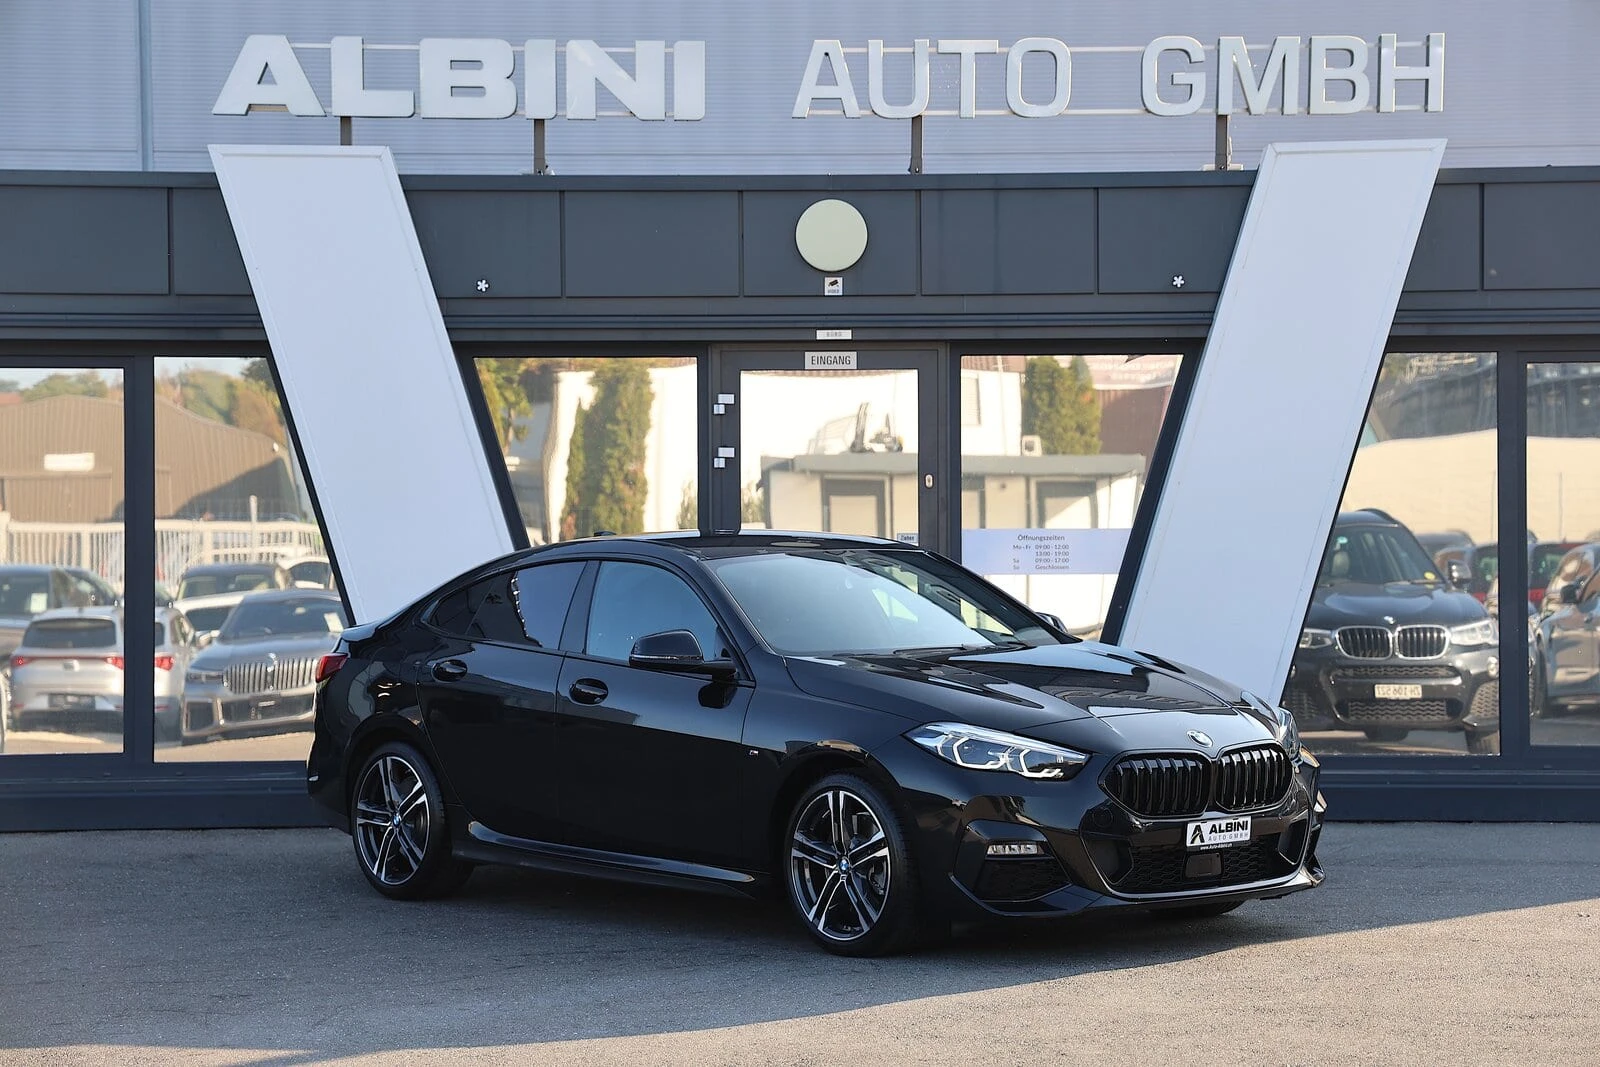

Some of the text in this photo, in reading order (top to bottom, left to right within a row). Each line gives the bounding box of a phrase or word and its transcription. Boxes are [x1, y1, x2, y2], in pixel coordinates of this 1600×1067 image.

[212, 33, 1445, 120] ALBINI AUTO GMBH
[811, 355, 851, 365] EINGANG
[1017, 533, 1065, 542] Öffnungszeiten
[1208, 820, 1249, 835] ALBINI
